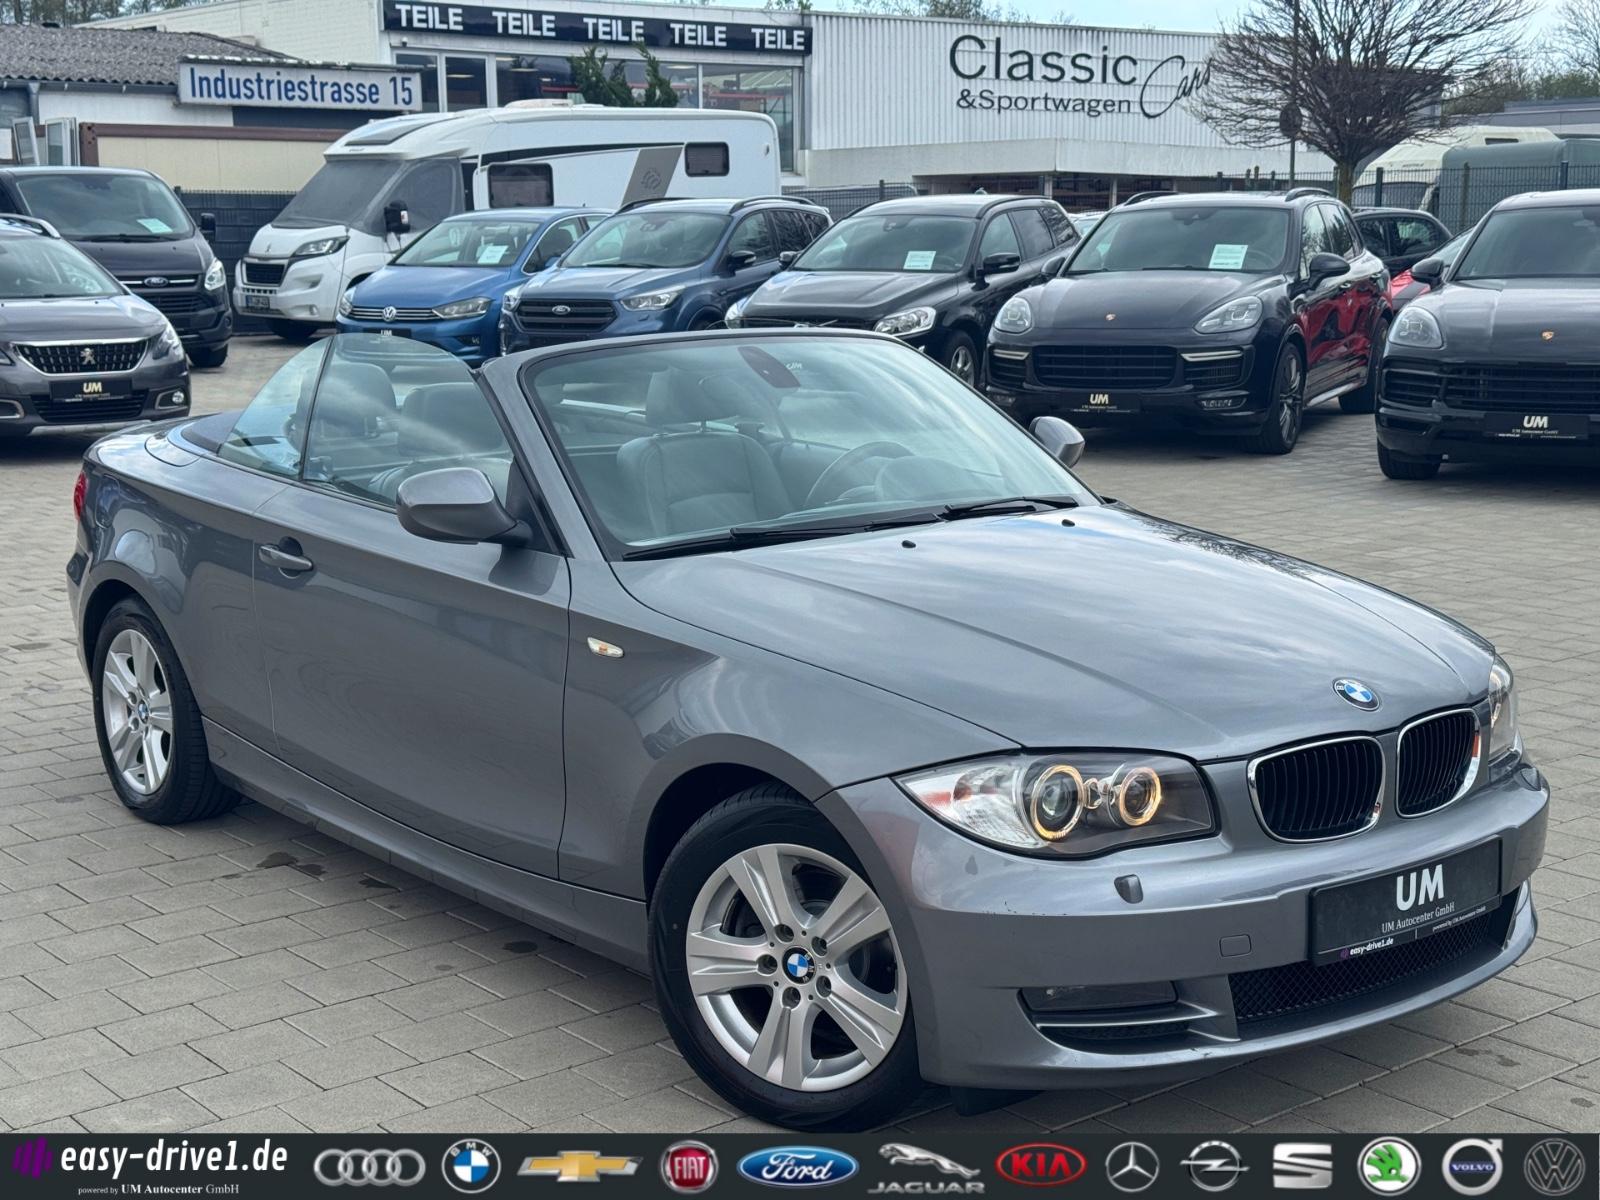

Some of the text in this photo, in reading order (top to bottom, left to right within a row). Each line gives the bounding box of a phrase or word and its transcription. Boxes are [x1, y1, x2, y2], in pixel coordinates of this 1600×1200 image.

[395, 4, 805, 50] TEILE TEILE TEILE TEILE TEILE
[950, 34, 1138, 85] Classic
[190, 67, 413, 106] Industriestrasse 15
[956, 88, 1131, 118] &Sportwagen
[83, 382, 102, 393] UM
[1089, 393, 1109, 405] UM
[1523, 415, 1549, 428] UM
[1396, 864, 1445, 911] UM
[1381, 921, 1395, 933] UM
[1396, 911, 1434, 930] Autocenter
[1435, 901, 1455, 917] GmbH
[1350, 937, 1394, 956] easy-drive1.de
